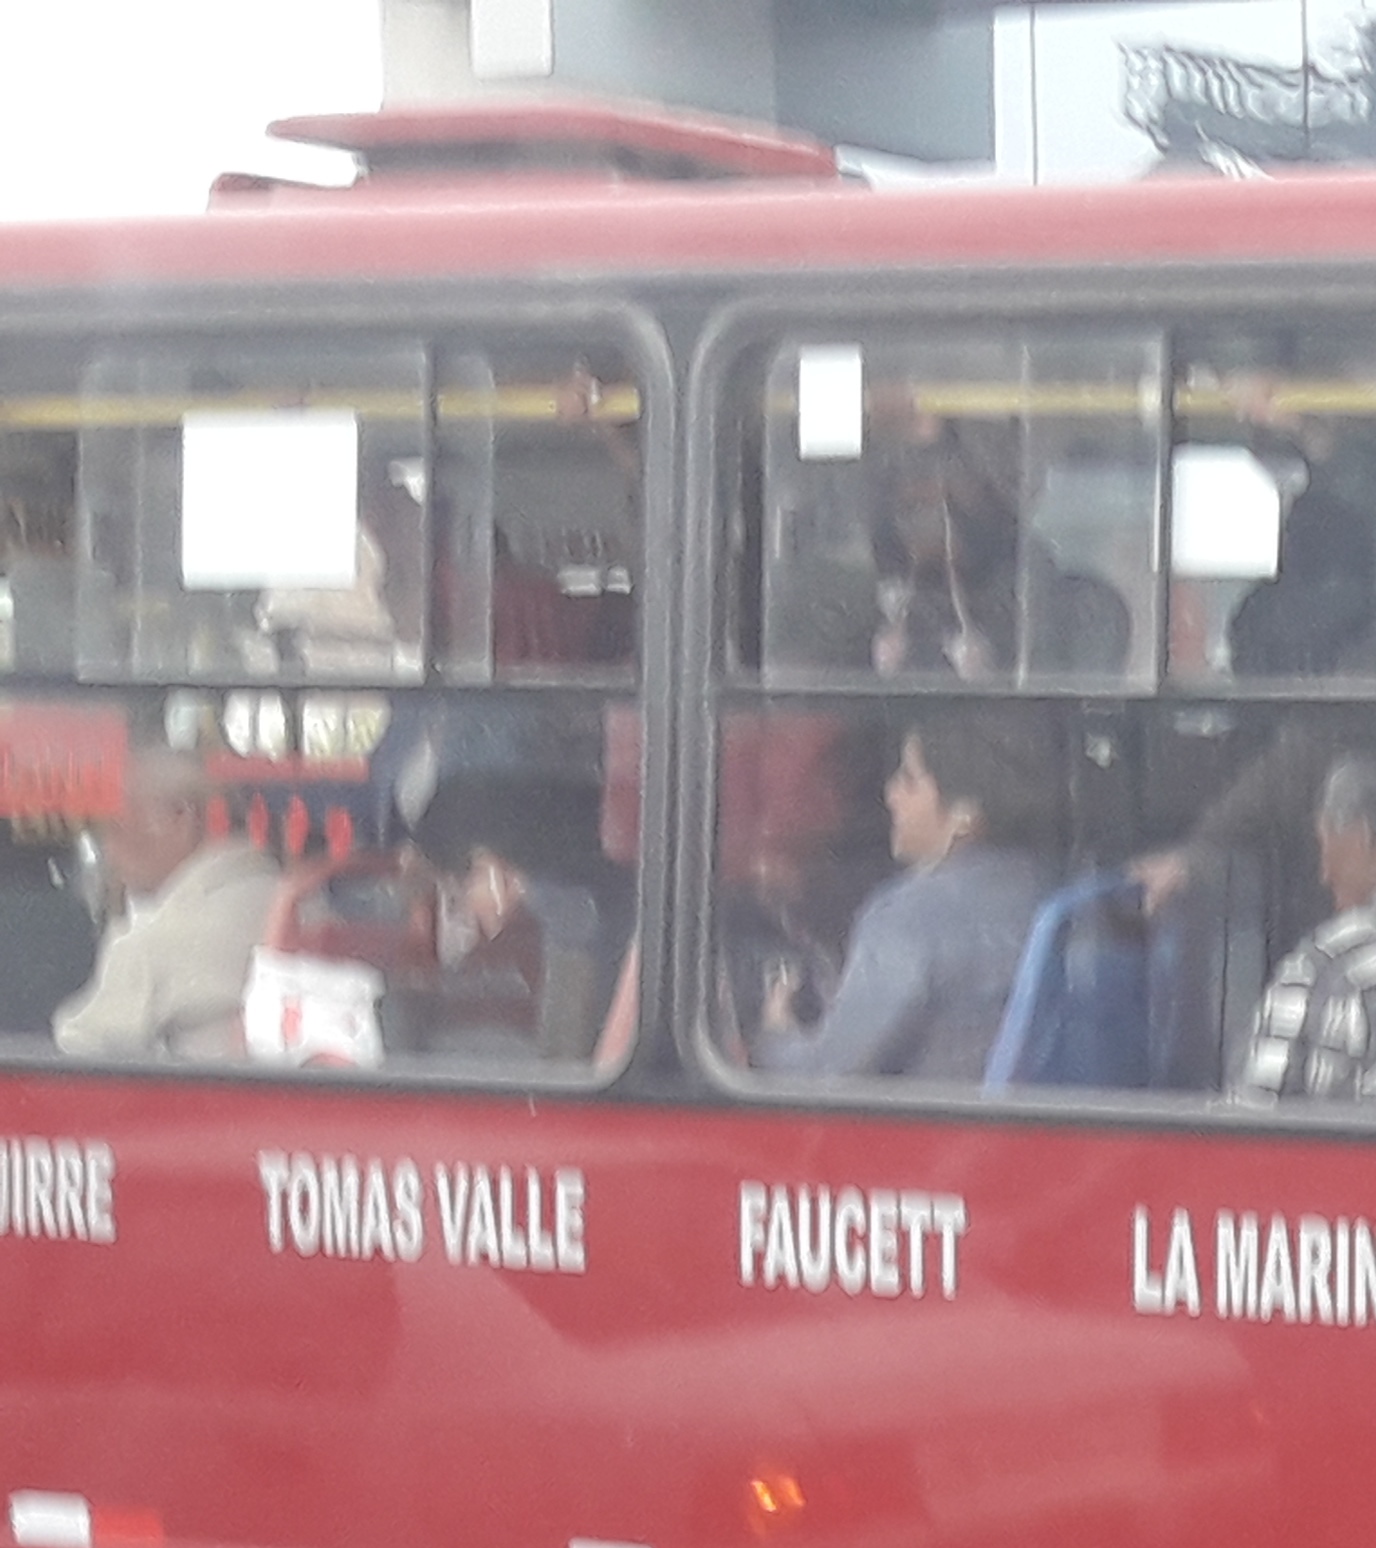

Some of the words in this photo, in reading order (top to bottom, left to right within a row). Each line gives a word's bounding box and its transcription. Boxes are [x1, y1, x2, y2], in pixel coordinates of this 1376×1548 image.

[256, 1147, 424, 1264] TOMAS
[436, 1159, 588, 1275] VALLE
[738, 1179, 968, 1302] FAUCETT
[1130, 1204, 1202, 1318] LA
